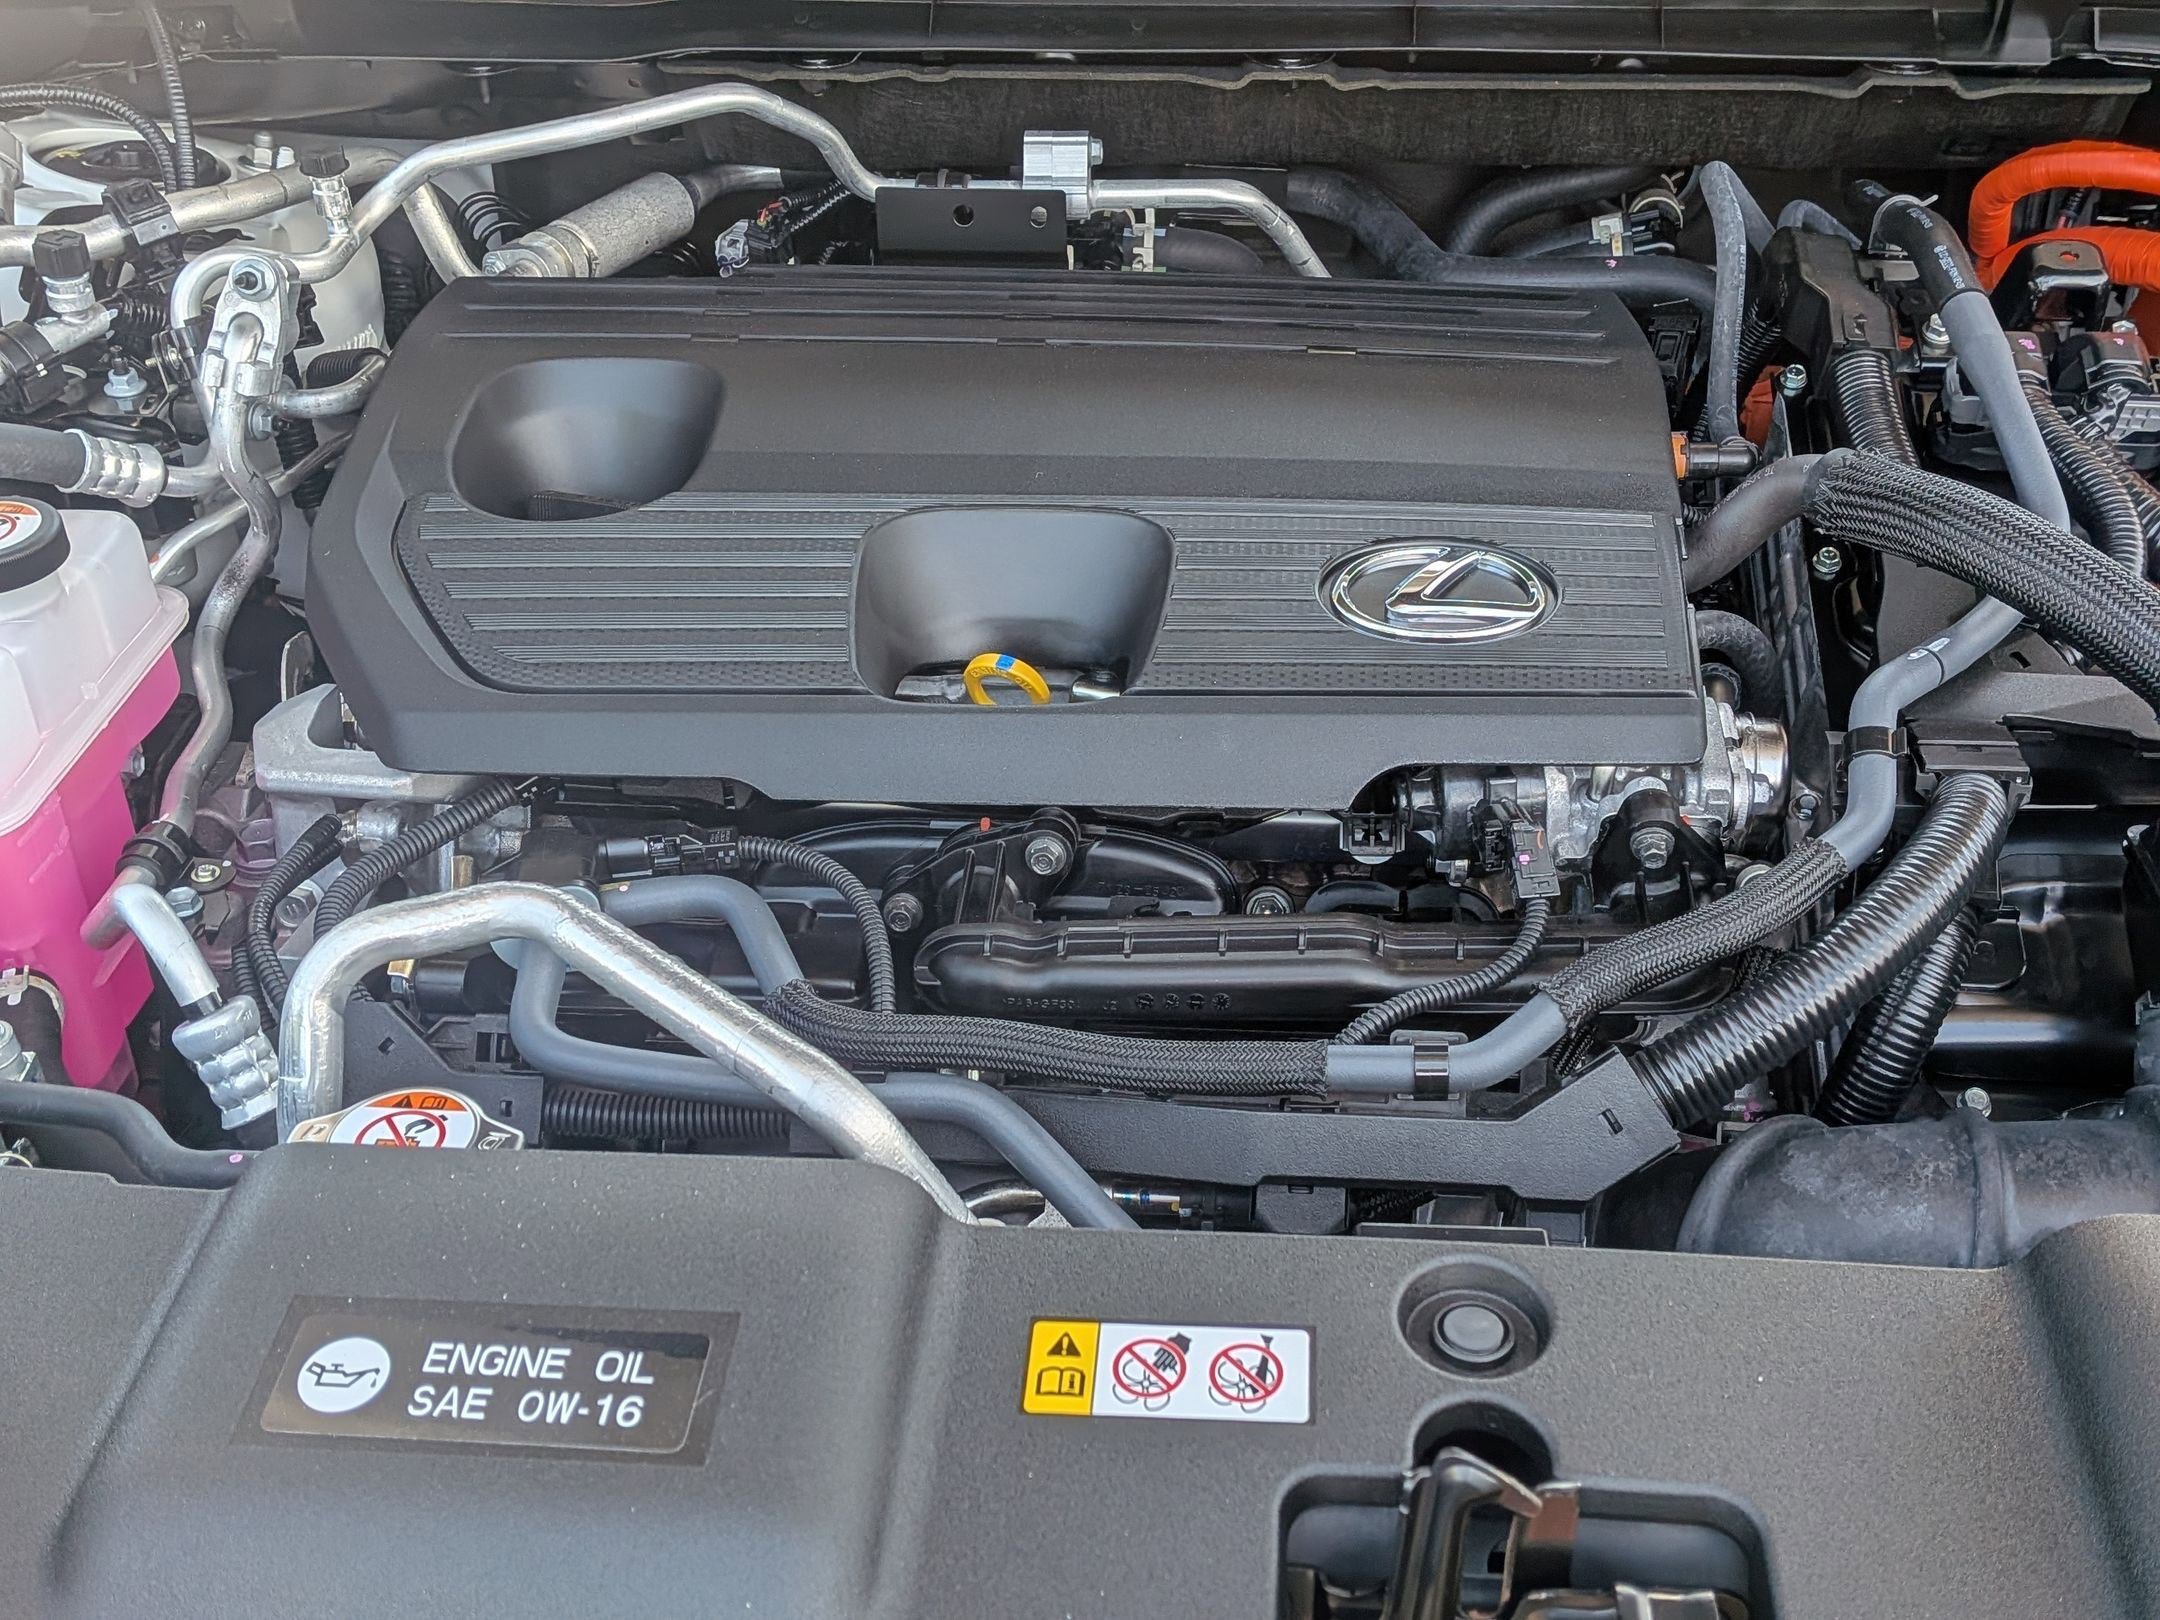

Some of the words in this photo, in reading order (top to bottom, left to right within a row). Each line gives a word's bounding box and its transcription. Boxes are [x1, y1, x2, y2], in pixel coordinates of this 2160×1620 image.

[421, 1341, 572, 1380] ENGINE
[594, 1350, 655, 1385] OIL
[406, 1384, 494, 1421] SAE
